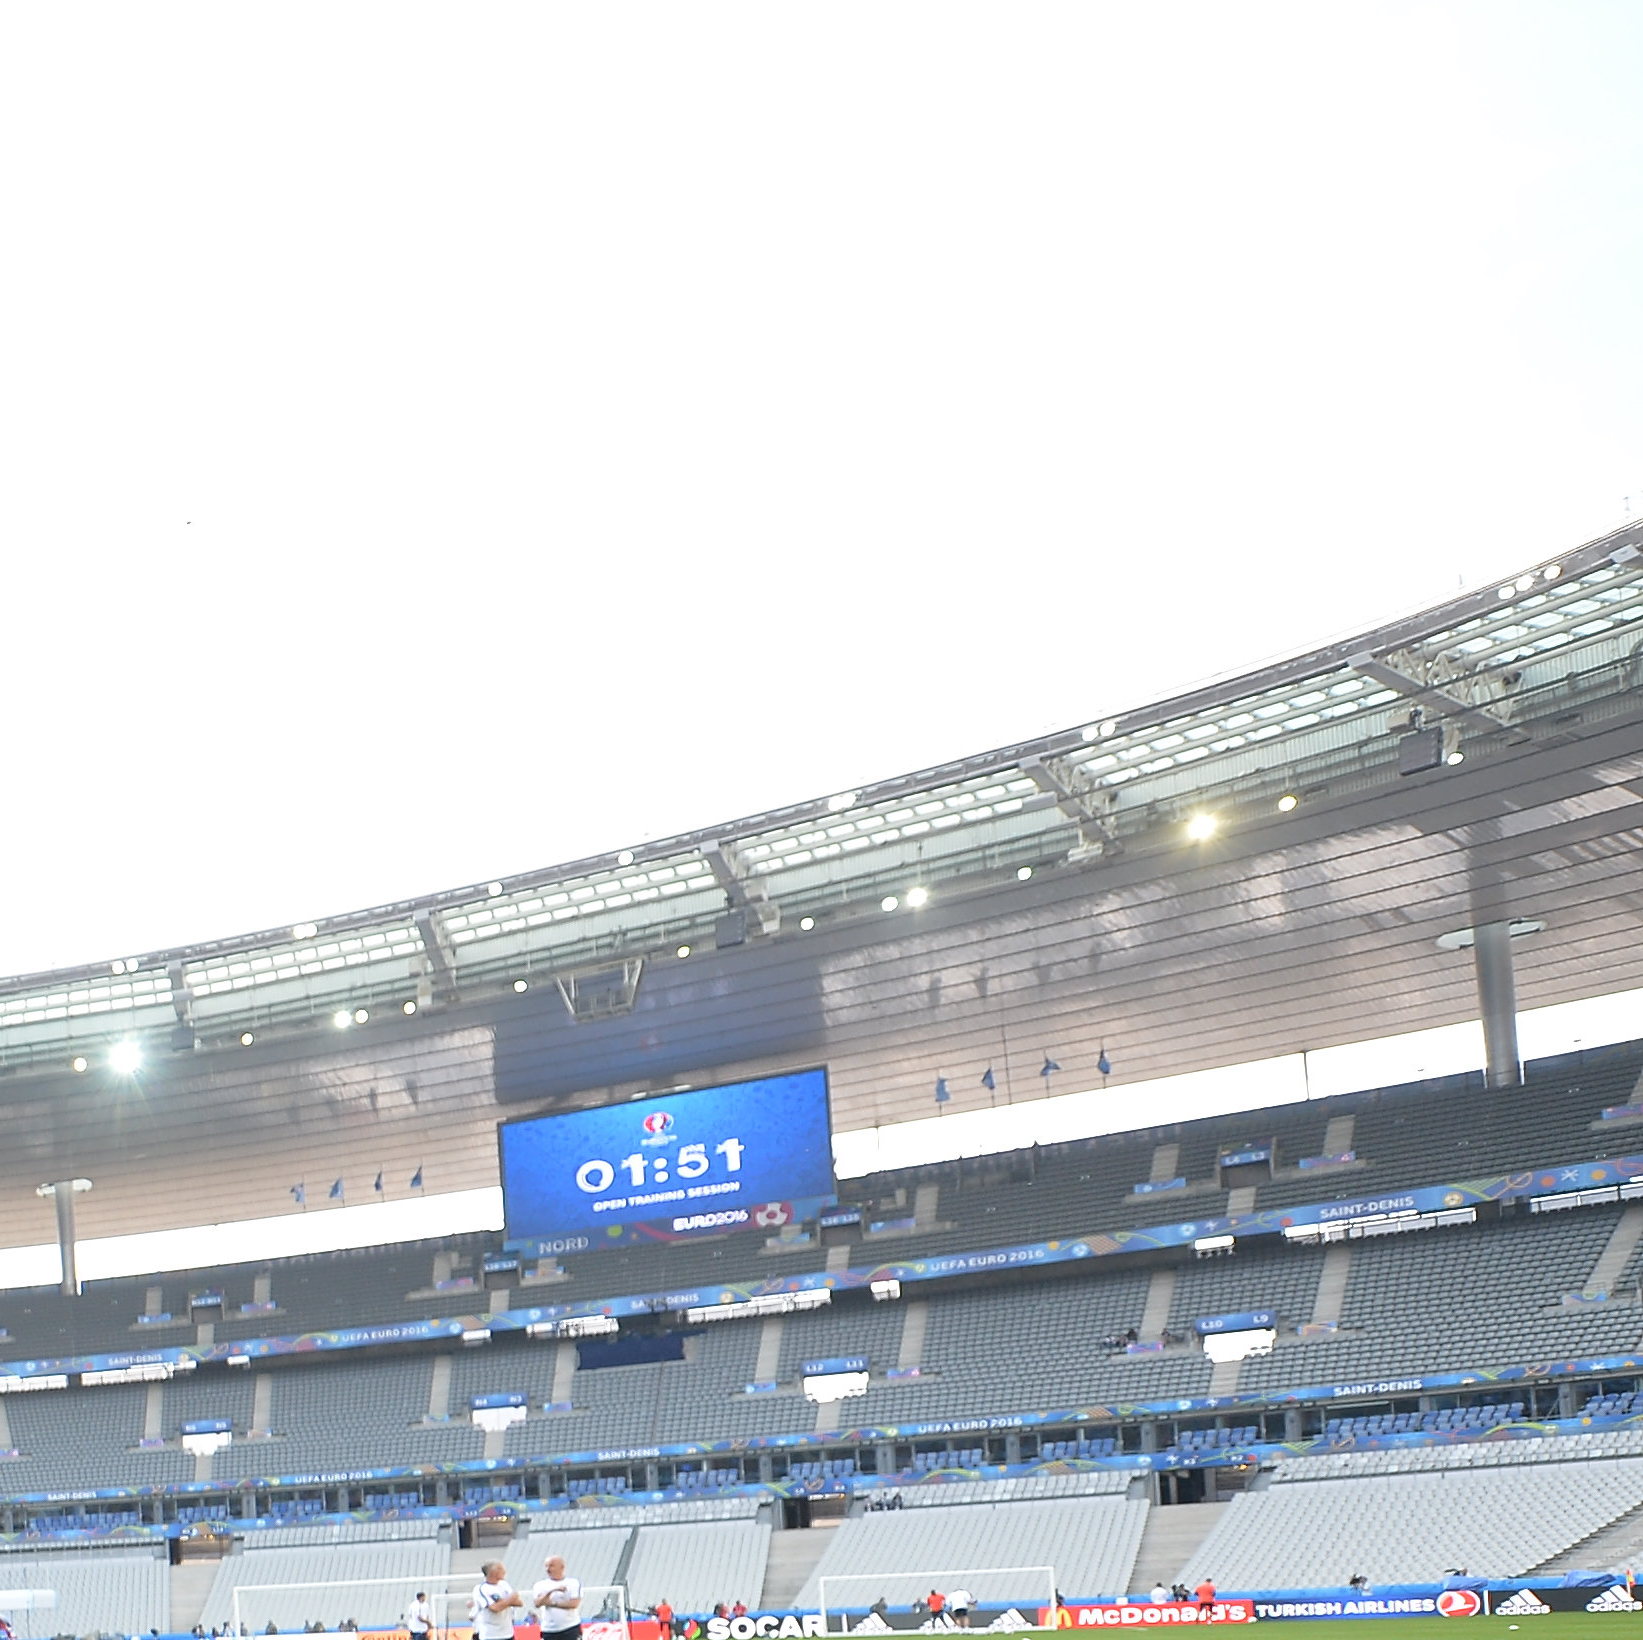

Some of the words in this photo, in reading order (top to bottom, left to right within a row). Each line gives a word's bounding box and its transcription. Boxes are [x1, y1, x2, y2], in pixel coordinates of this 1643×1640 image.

[576, 1137, 745, 1193] 01:51
[592, 1197, 627, 1212] OPEN
[628, 1190, 686, 1207] TRAINING
[687, 1181, 741, 1199] SESSION
[1320, 1196, 1414, 1219] SAINT-DENIS
[539, 1235, 589, 1255] NORD
[930, 1260, 966, 1272] UEFA
[968, 1254, 1007, 1266] EURO
[1010, 1249, 1045, 1262] 2016
[1201, 1320, 1223, 1330] L10
[1253, 1314, 1269, 1324] L9
[342, 1334, 369, 1342] UEFA
[371, 1329, 400, 1340] EURO
[401, 1325, 429, 1336] 2016
[108, 1353, 163, 1366] SAINT-DENIS
[1333, 1380, 1423, 1398] SAINT-DENIS
[918, 1423, 951, 1434] UEFA
[953, 1420, 988, 1432] EURO
[990, 1416, 1023, 1428] 2016
[598, 1448, 660, 1461] SAINT-DENIS
[295, 1476, 321, 1484] UEFA
[322, 1473, 348, 1481] EURO
[349, 1470, 373, 1479] 2016
[47, 1490, 97, 1500] SAINT-DENIS
[1256, 1602, 1342, 1618] TURKISH
[1343, 1599, 1436, 1615] AIRLINES
[1495, 1604, 1551, 1616] adidas
[1586, 1600, 1643, 1613] adidas
[706, 1614, 827, 1640] SOCAR
